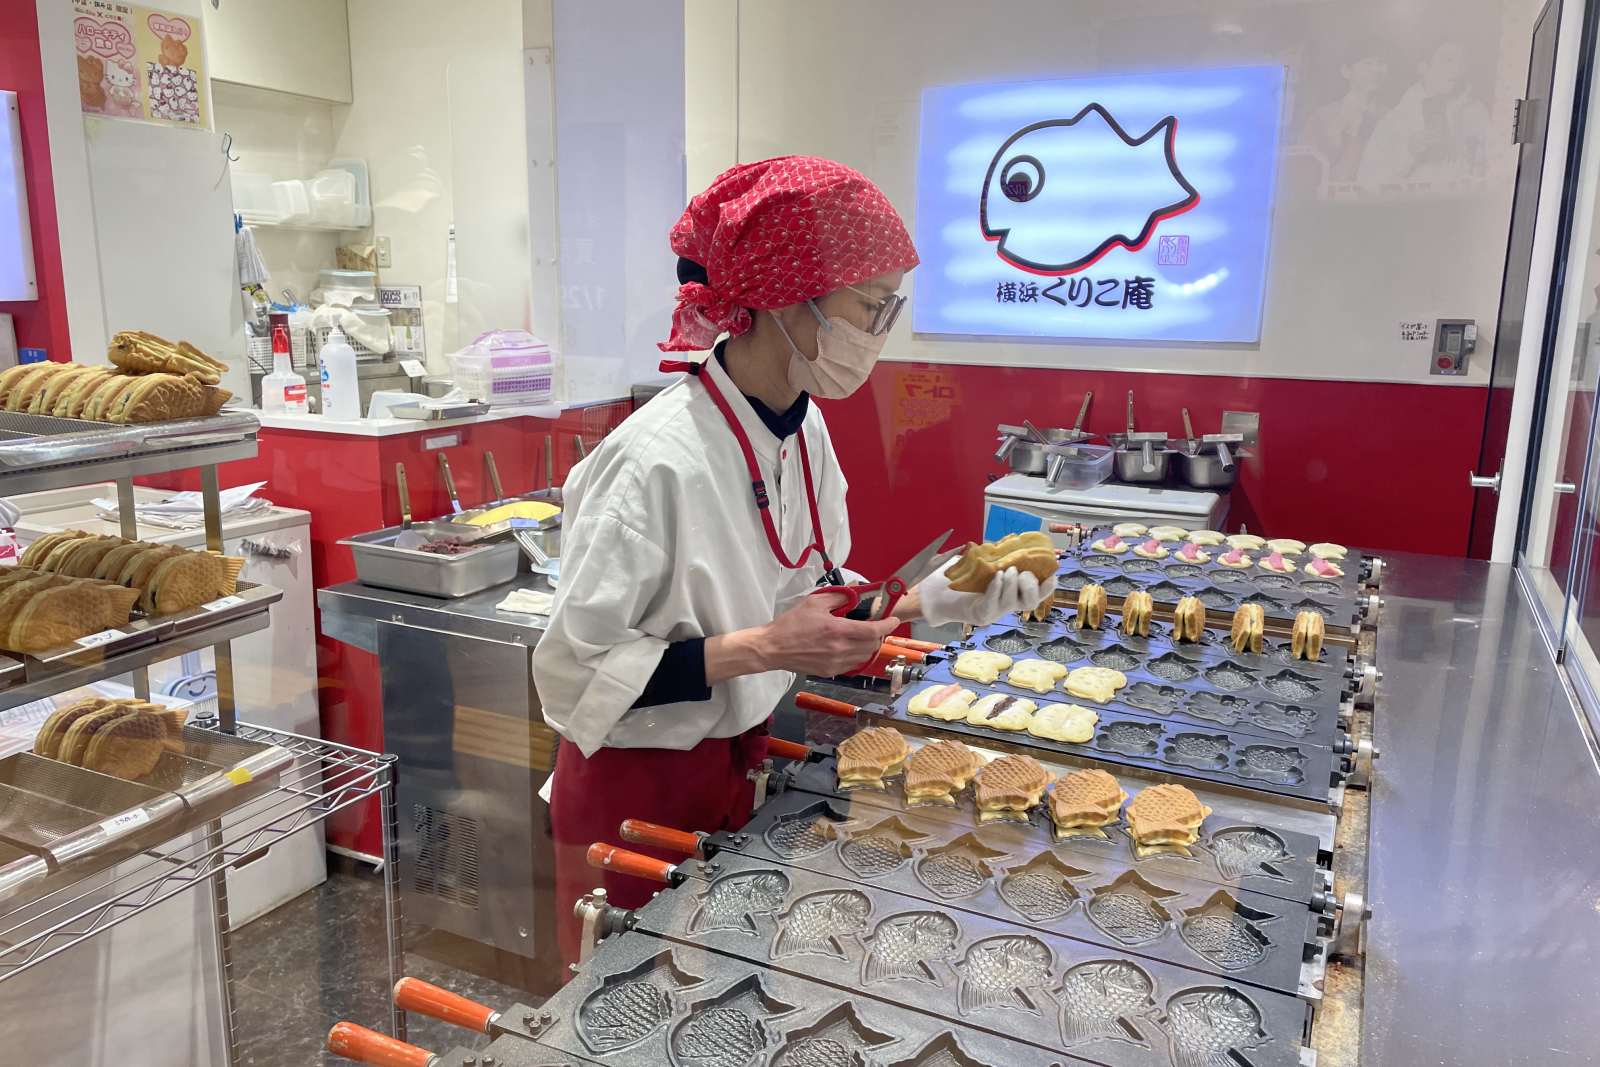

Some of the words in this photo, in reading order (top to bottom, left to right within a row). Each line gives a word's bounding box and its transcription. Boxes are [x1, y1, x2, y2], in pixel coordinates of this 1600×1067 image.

[78, 23, 126, 42] ハローキティ
[996, 275, 1156, 310] 横浜くりこ庵
